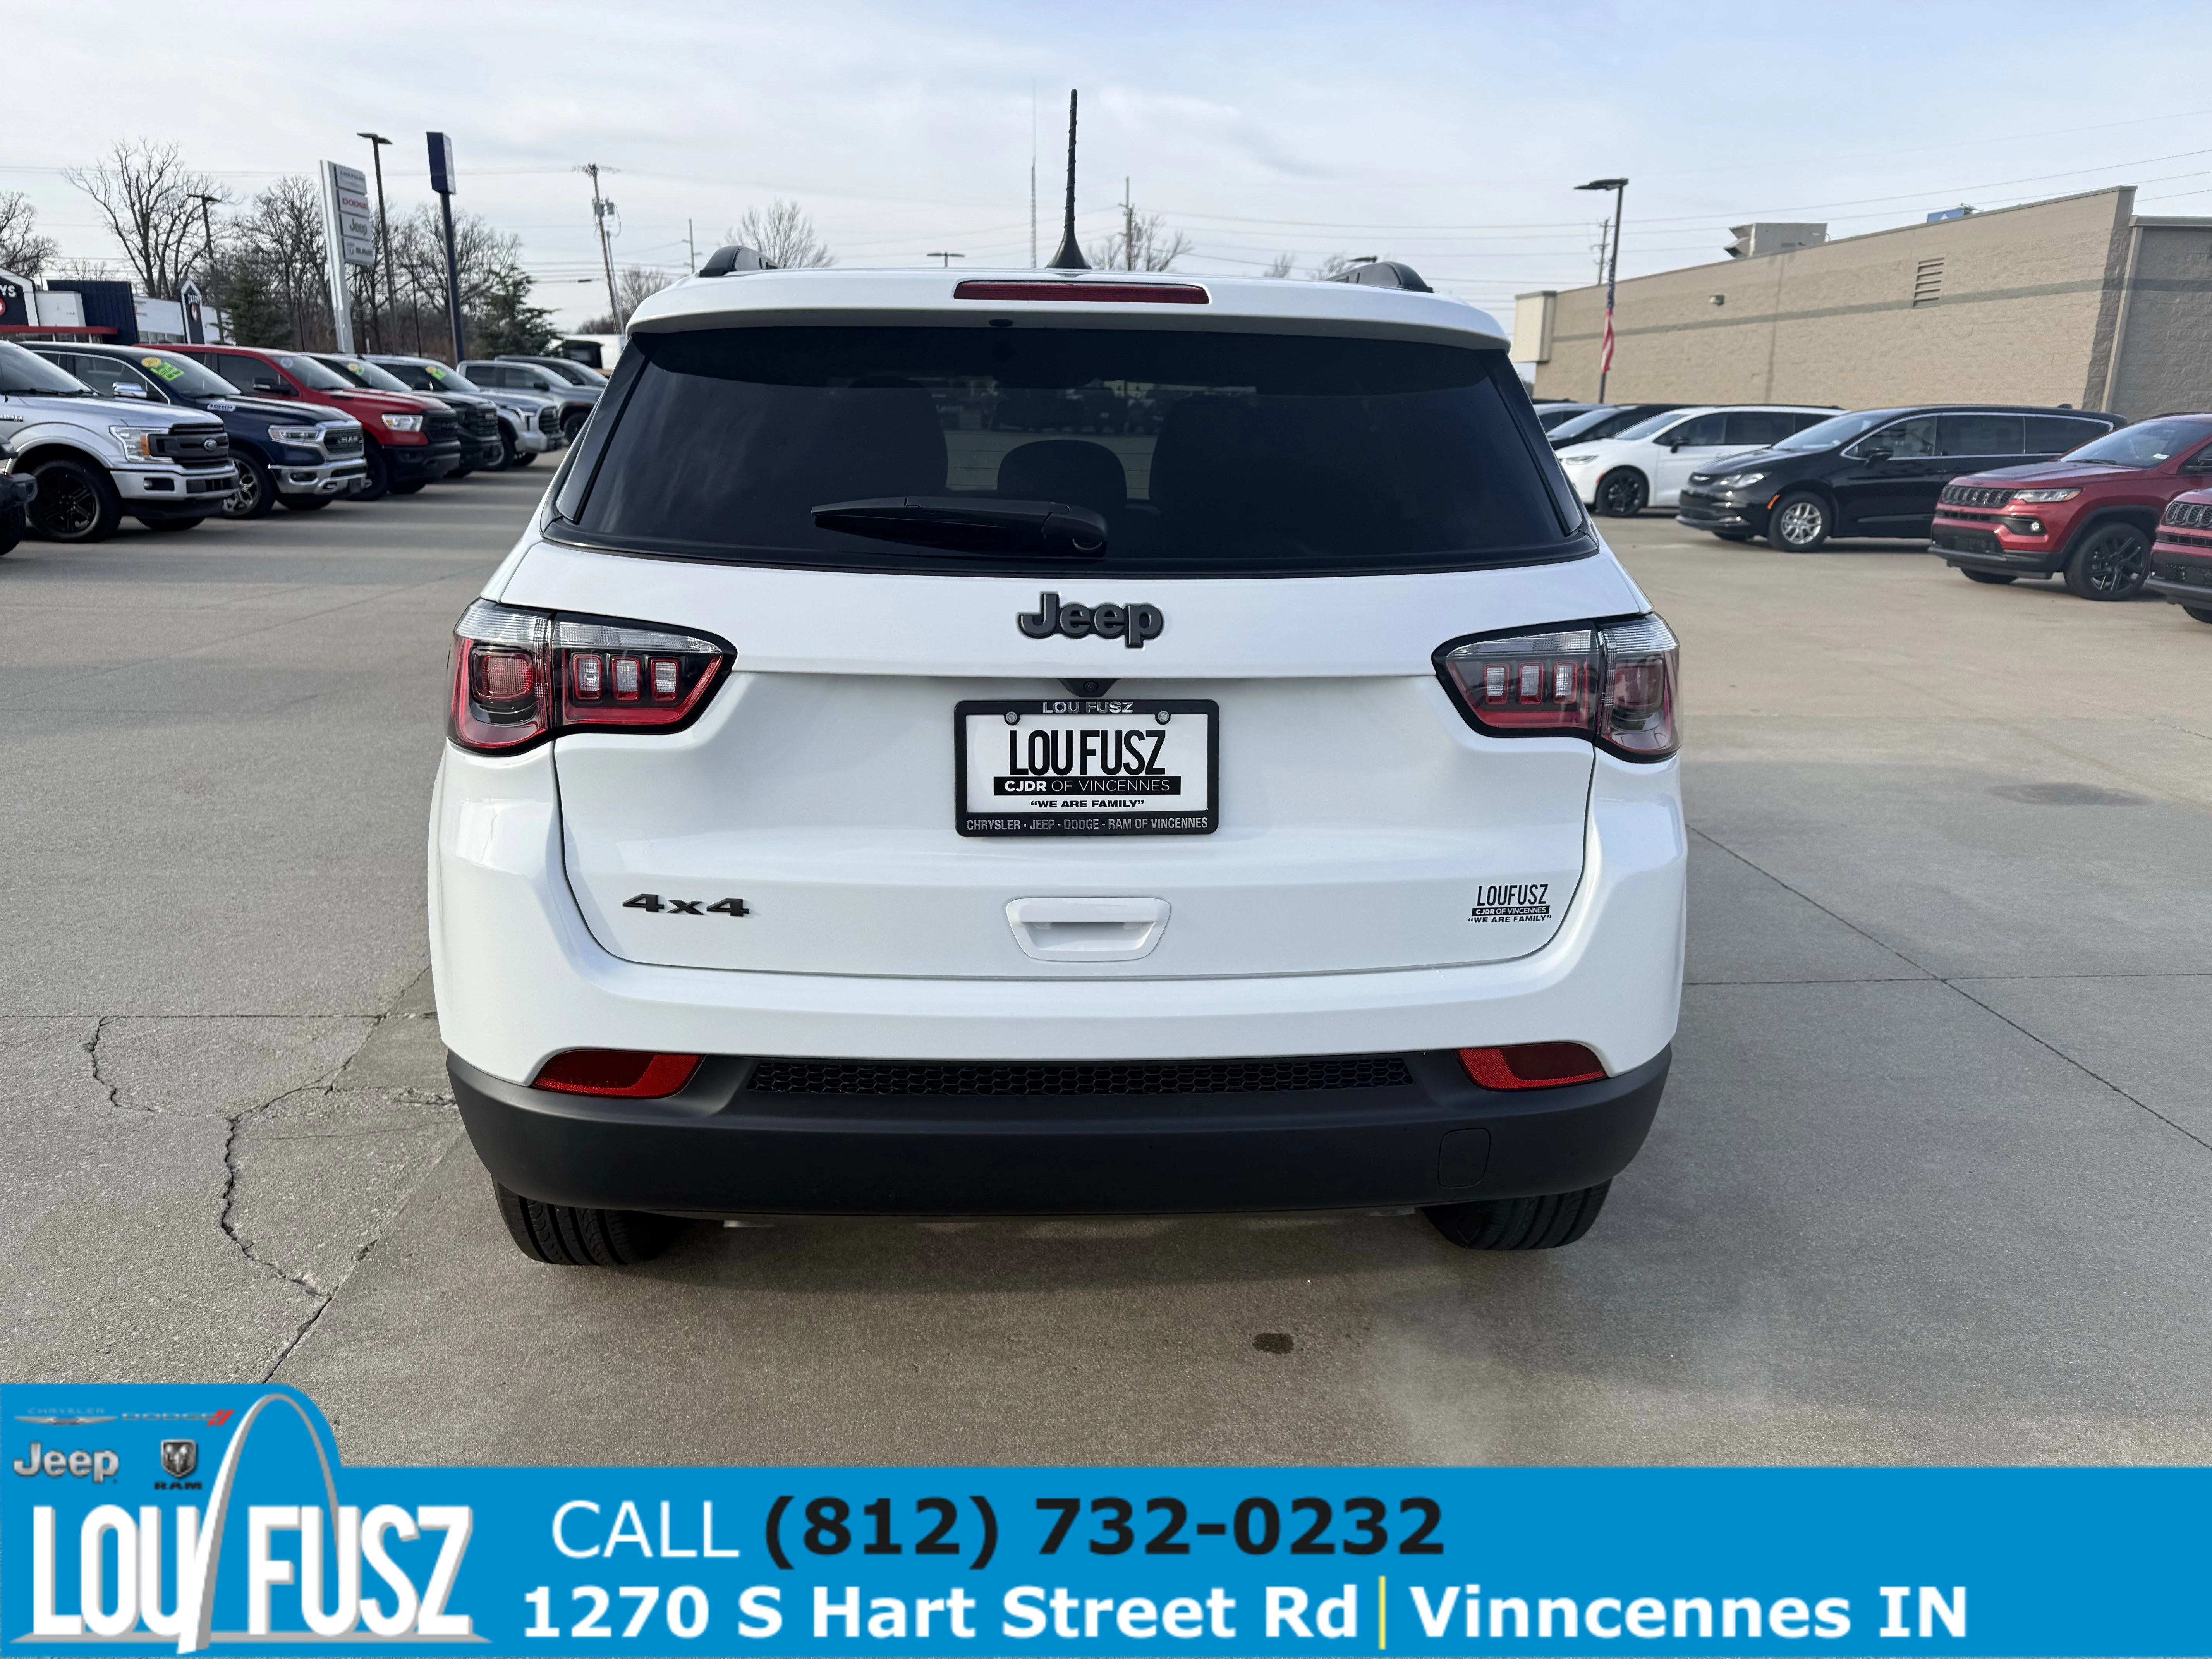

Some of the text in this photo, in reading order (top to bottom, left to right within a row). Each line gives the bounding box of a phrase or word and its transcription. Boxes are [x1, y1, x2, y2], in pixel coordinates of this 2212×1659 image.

[1018, 592, 1163, 649] Jeep
[1042, 701, 1133, 714] LOU FUSZ
[1009, 730, 1166, 776] LOU FUSZ
[1005, 780, 1170, 792] CJDR OF VINCENNES
[967, 817, 1208, 831] CHRYSLER JEEP DODGE RAM OF VINCENNES
[622, 893, 750, 917] 4x4
